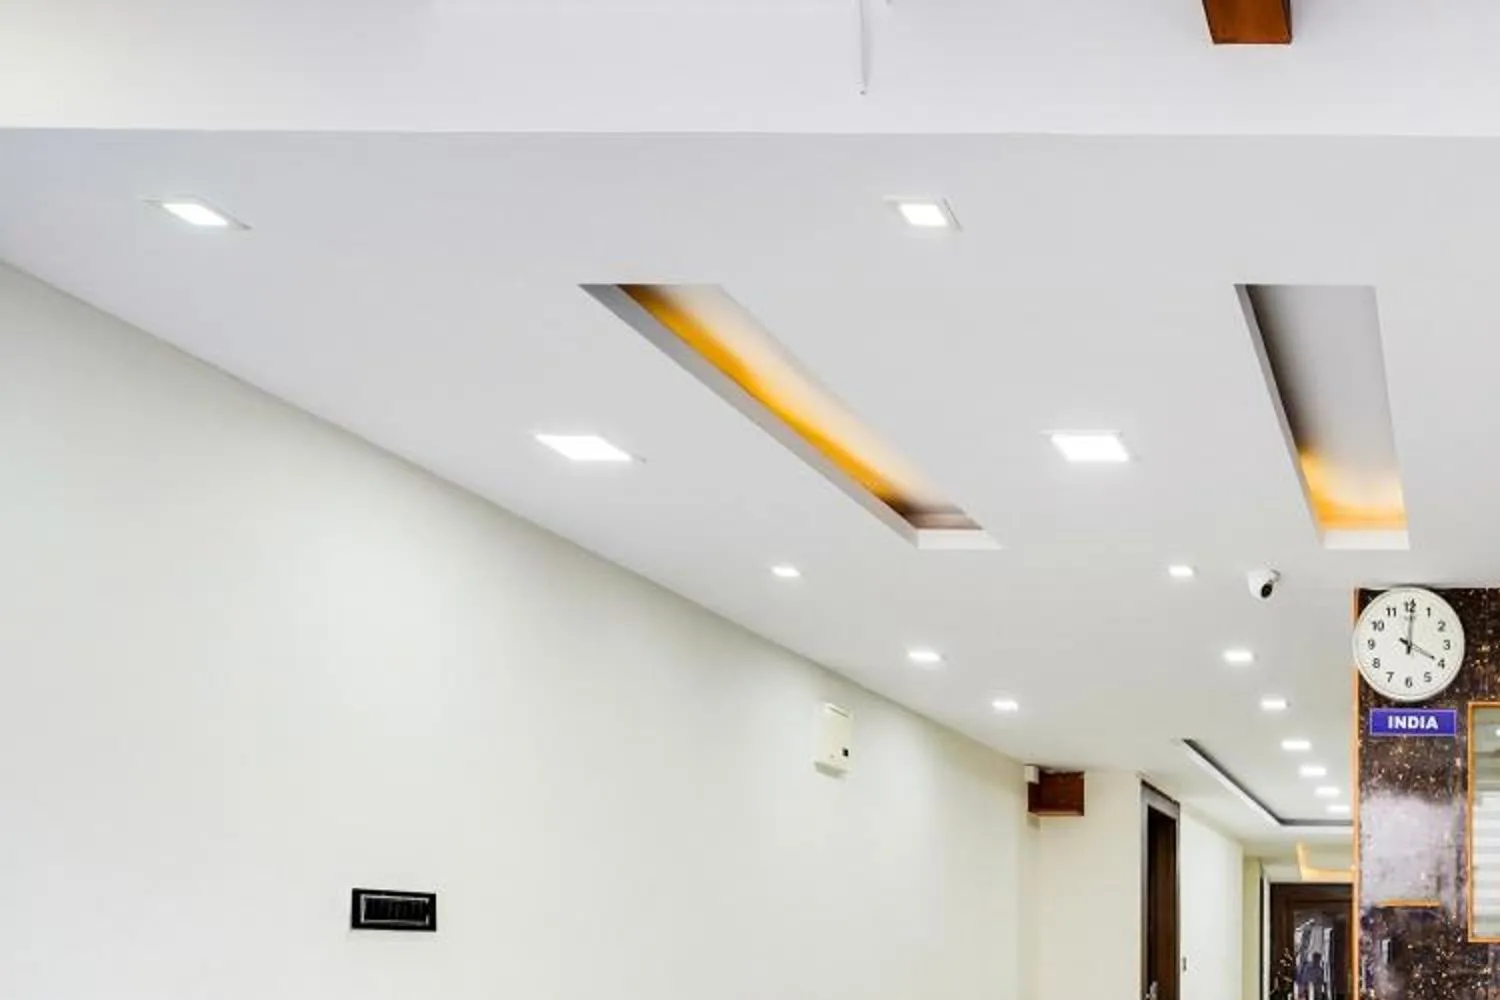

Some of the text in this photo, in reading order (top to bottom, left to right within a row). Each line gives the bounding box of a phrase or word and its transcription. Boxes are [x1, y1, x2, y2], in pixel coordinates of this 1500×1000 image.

[1386, 607, 1397, 617] 11
[1426, 607, 1431, 617] 1
[1372, 621, 1384, 631] 10
[1438, 621, 1446, 631] 2
[1368, 639, 1375, 649] 9
[1444, 640, 1451, 650] 3
[1372, 658, 1380, 668] 8
[1438, 659, 1445, 669] 4
[1386, 672, 1394, 682] 7
[1424, 672, 1432, 682] 5
[1405, 677, 1413, 688] 6
[1388, 715, 1438, 729] INDIA
